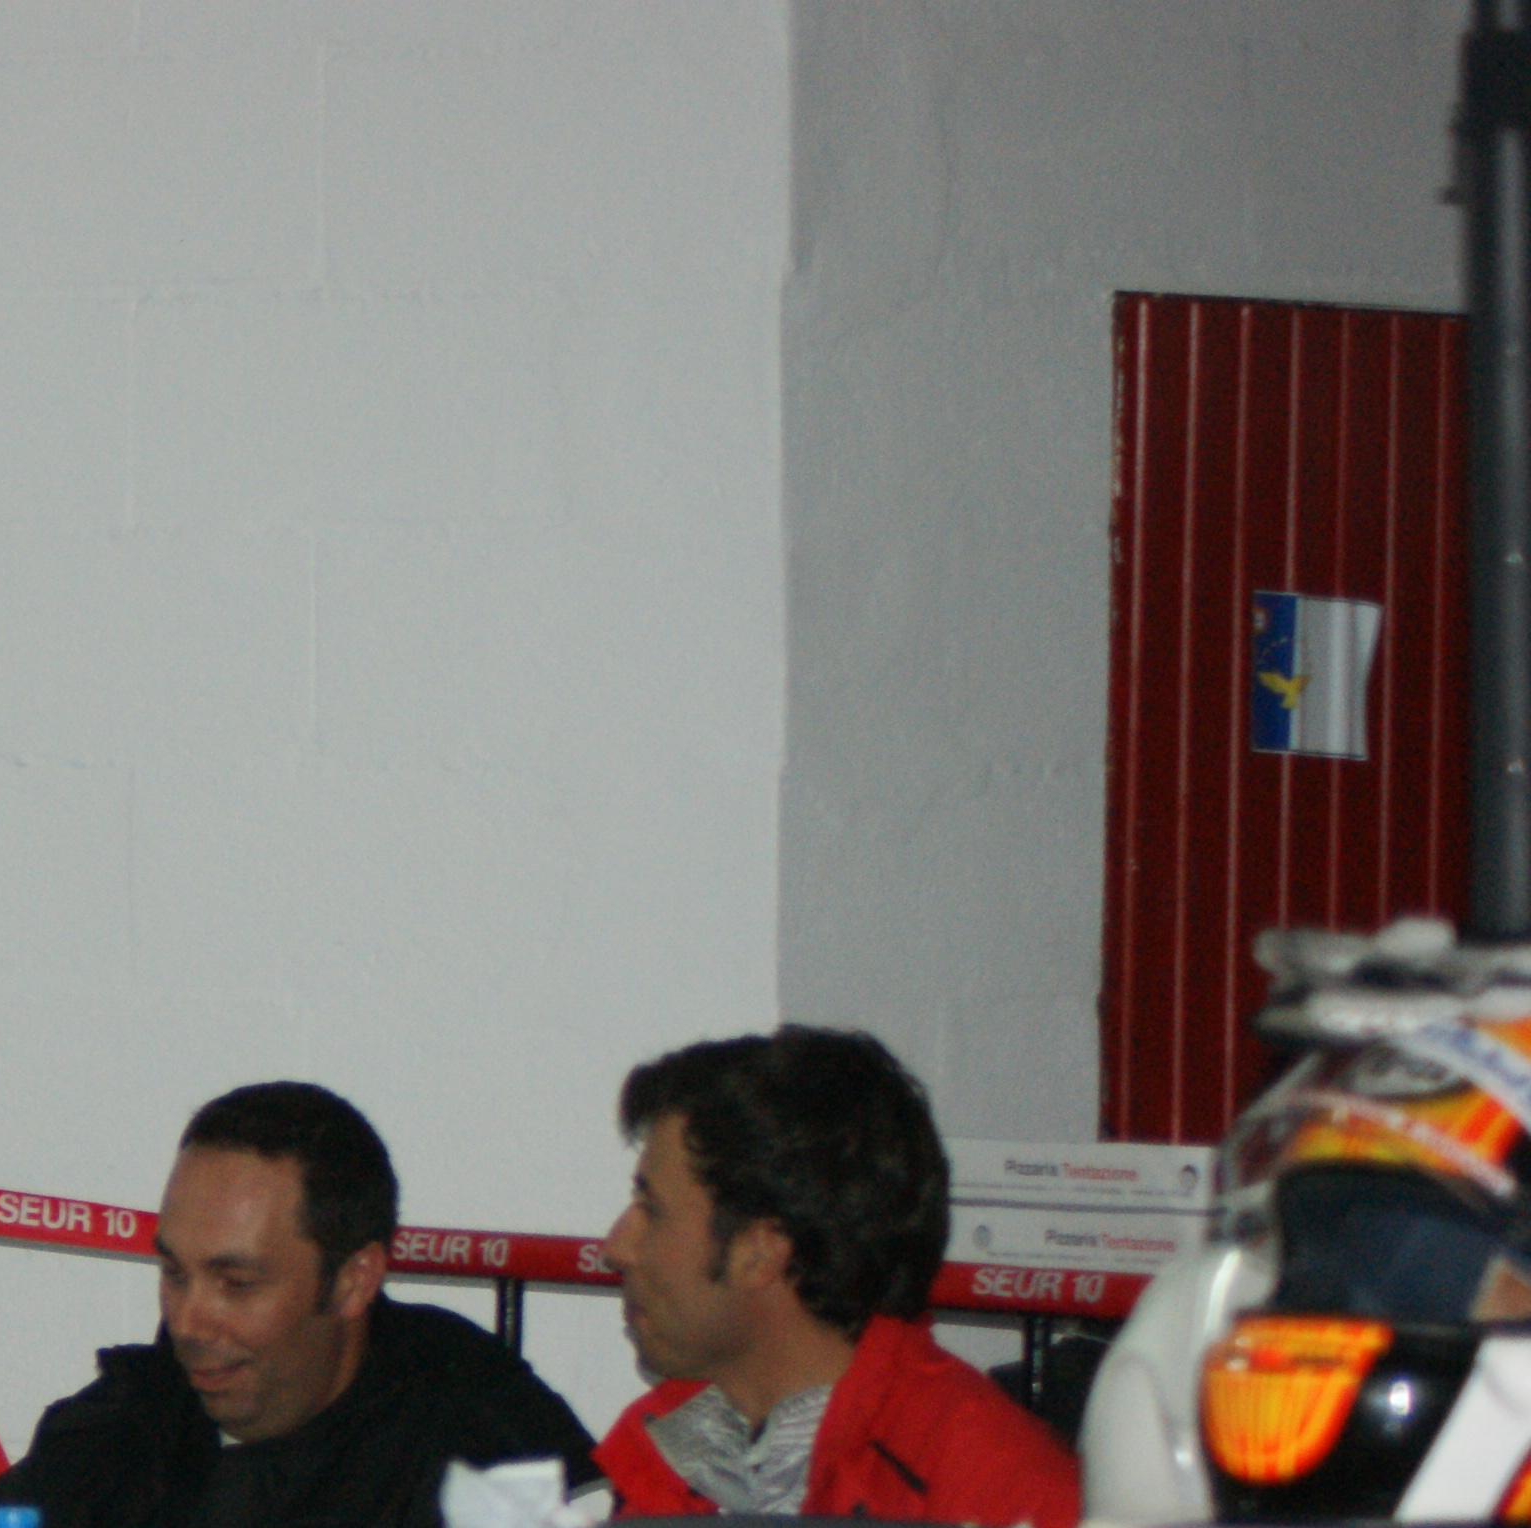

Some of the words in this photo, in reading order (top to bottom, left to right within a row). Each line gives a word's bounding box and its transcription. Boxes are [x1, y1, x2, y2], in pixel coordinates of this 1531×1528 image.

[102, 1208, 137, 1239] 10
[392, 1231, 472, 1265] SEUR
[479, 1237, 509, 1268] 10
[971, 1267, 1063, 1300] SEUR
[1070, 1274, 1106, 1303] 10
